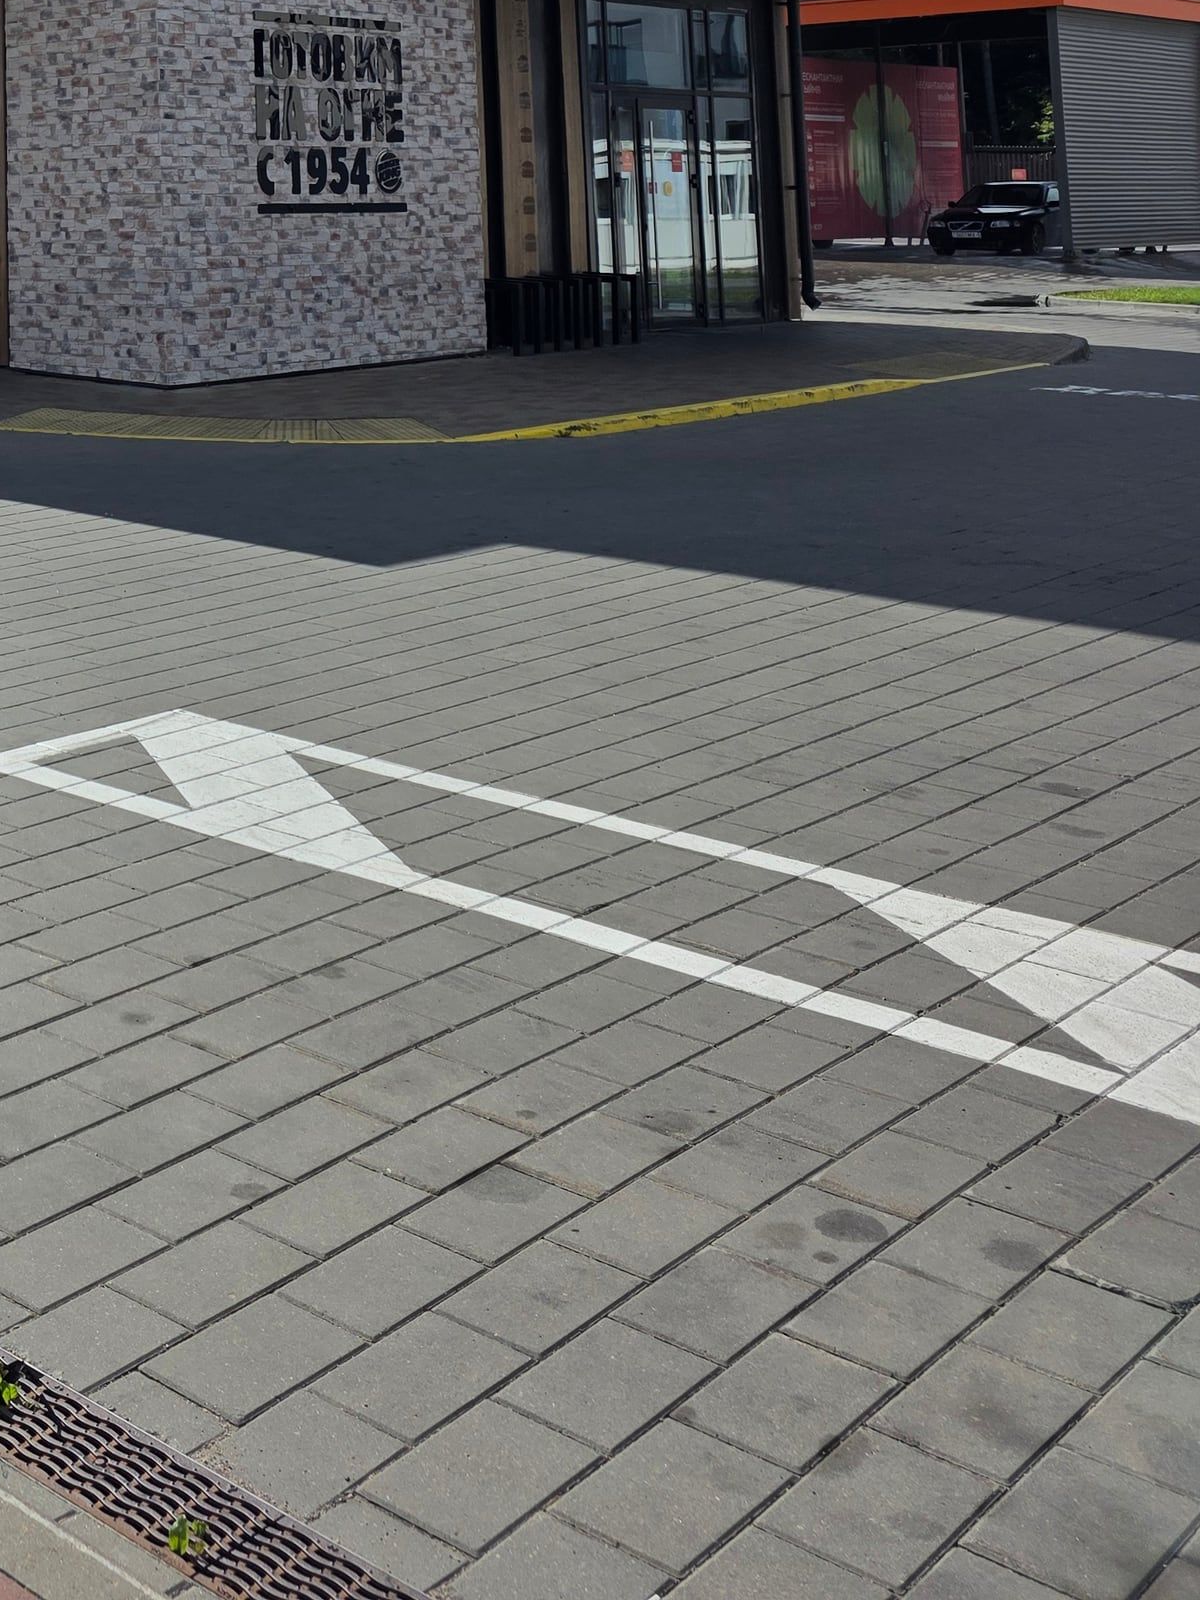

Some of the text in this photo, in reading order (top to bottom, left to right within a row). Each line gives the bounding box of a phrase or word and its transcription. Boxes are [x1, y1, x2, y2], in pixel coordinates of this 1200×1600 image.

[253, 28, 402, 84] ГОТОВИМ
[255, 85, 405, 143] НА ОГНЕ
[256, 146, 371, 196] С 1954
